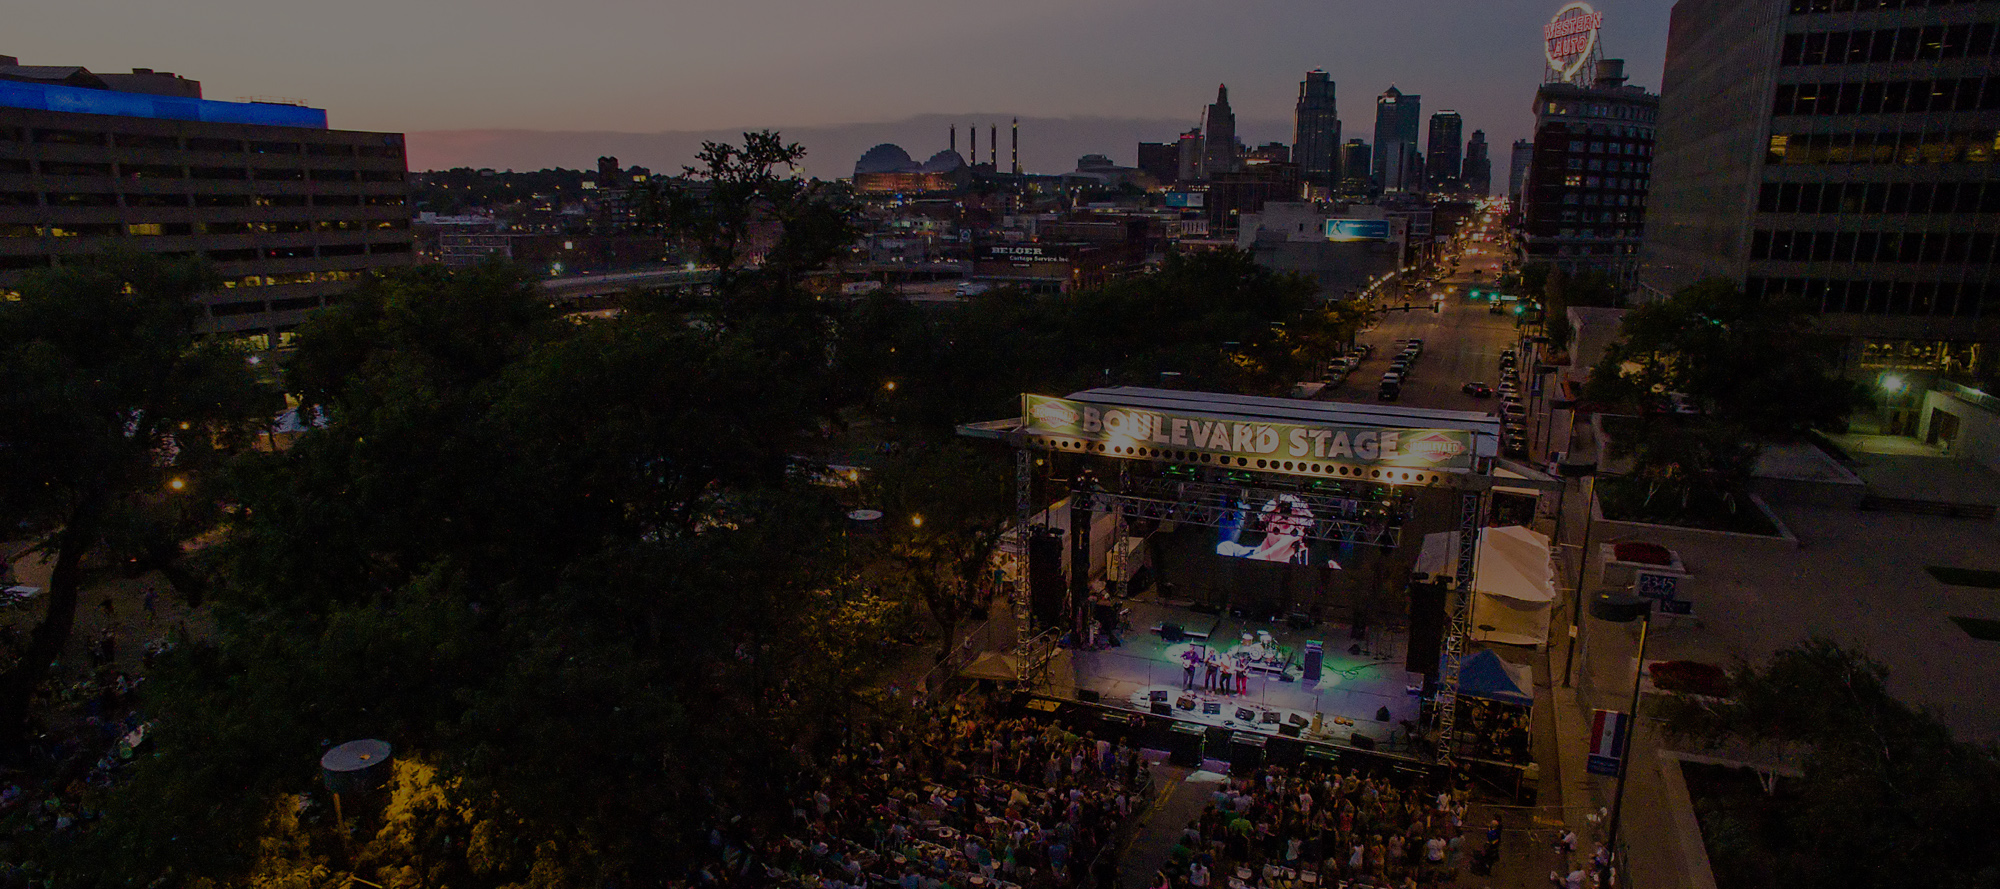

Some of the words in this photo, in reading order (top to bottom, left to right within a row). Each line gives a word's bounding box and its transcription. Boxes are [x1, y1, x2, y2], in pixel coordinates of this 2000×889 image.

[1544, 11, 1602, 40] WESTERN
[1554, 35, 1587, 57] AUTO
[1083, 406, 1280, 453] BOULEVARD
[1288, 427, 1401, 459] STAGE
[1412, 441, 1459, 452] BOULEVARD
